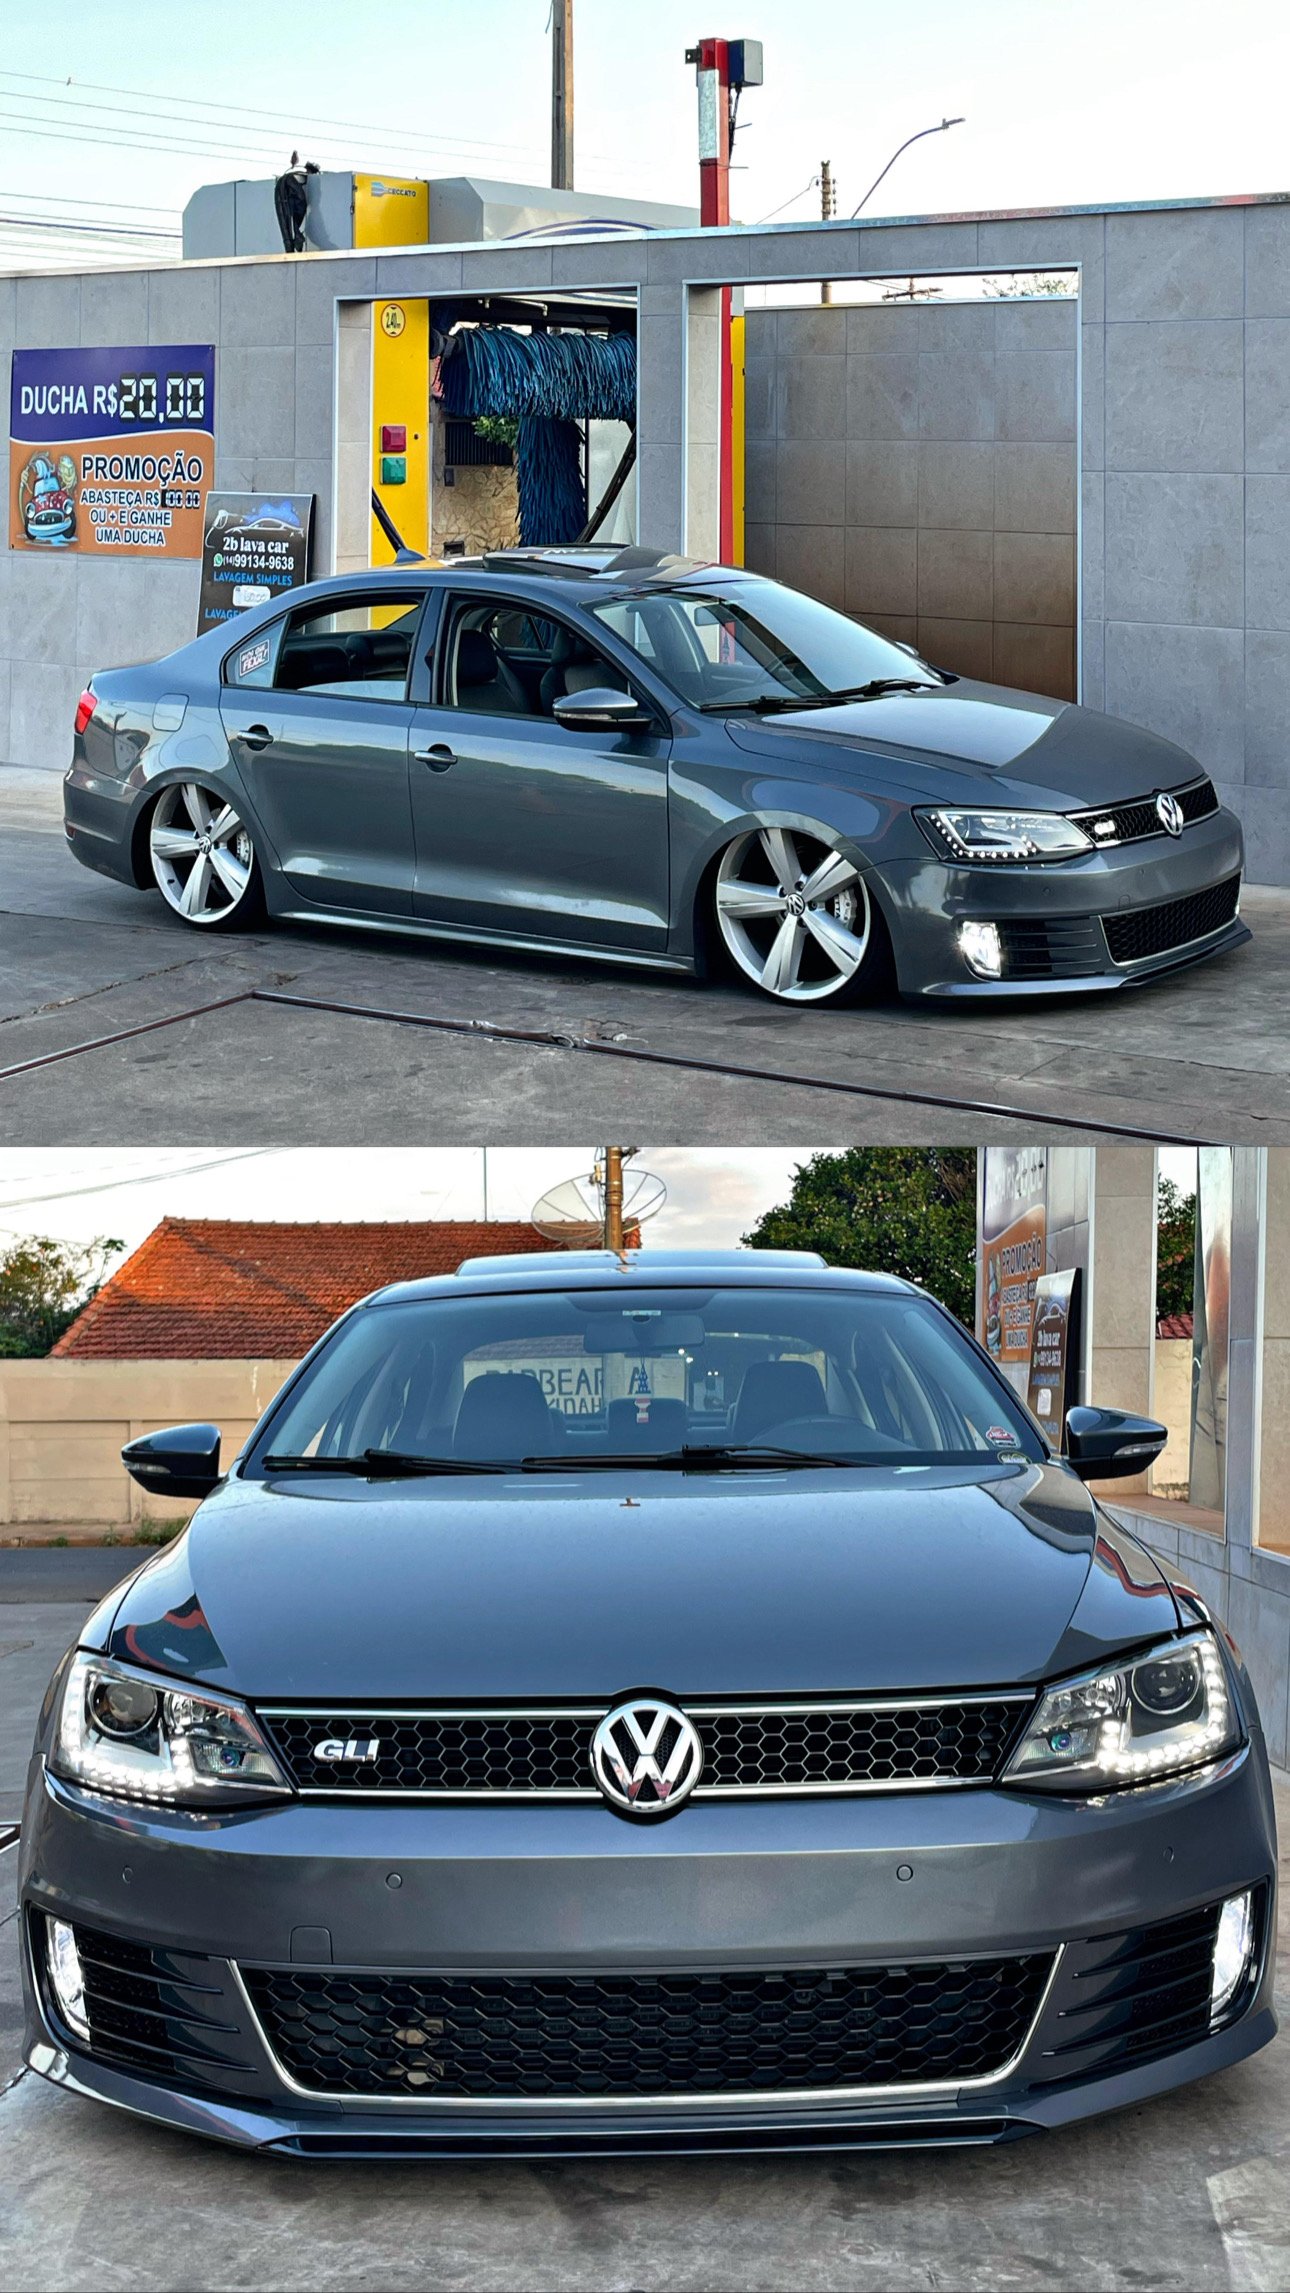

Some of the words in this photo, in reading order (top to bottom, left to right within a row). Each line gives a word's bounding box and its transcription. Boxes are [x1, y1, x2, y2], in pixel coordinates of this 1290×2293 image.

[21, 386, 88, 414] DUCHA
[81, 450, 203, 487] PROMOÇÃO
[81, 490, 142, 507] ABASTEÇA
[90, 509, 106, 523] OU
[119, 510, 127, 524] E
[130, 511, 171, 526] GANHE
[96, 529, 121, 542] UMA
[124, 529, 165, 545] DUCHA
[223, 537, 239, 551] 2b
[240, 537, 265, 552] lava
[267, 542, 289, 554] car
[213, 571, 254, 584] LAVAGEM
[256, 573, 293, 586] SIMPLES
[204, 607, 242, 620] LAVAGE
[313, 1739, 380, 1762] GLI
[591, 1699, 701, 1812] VW
